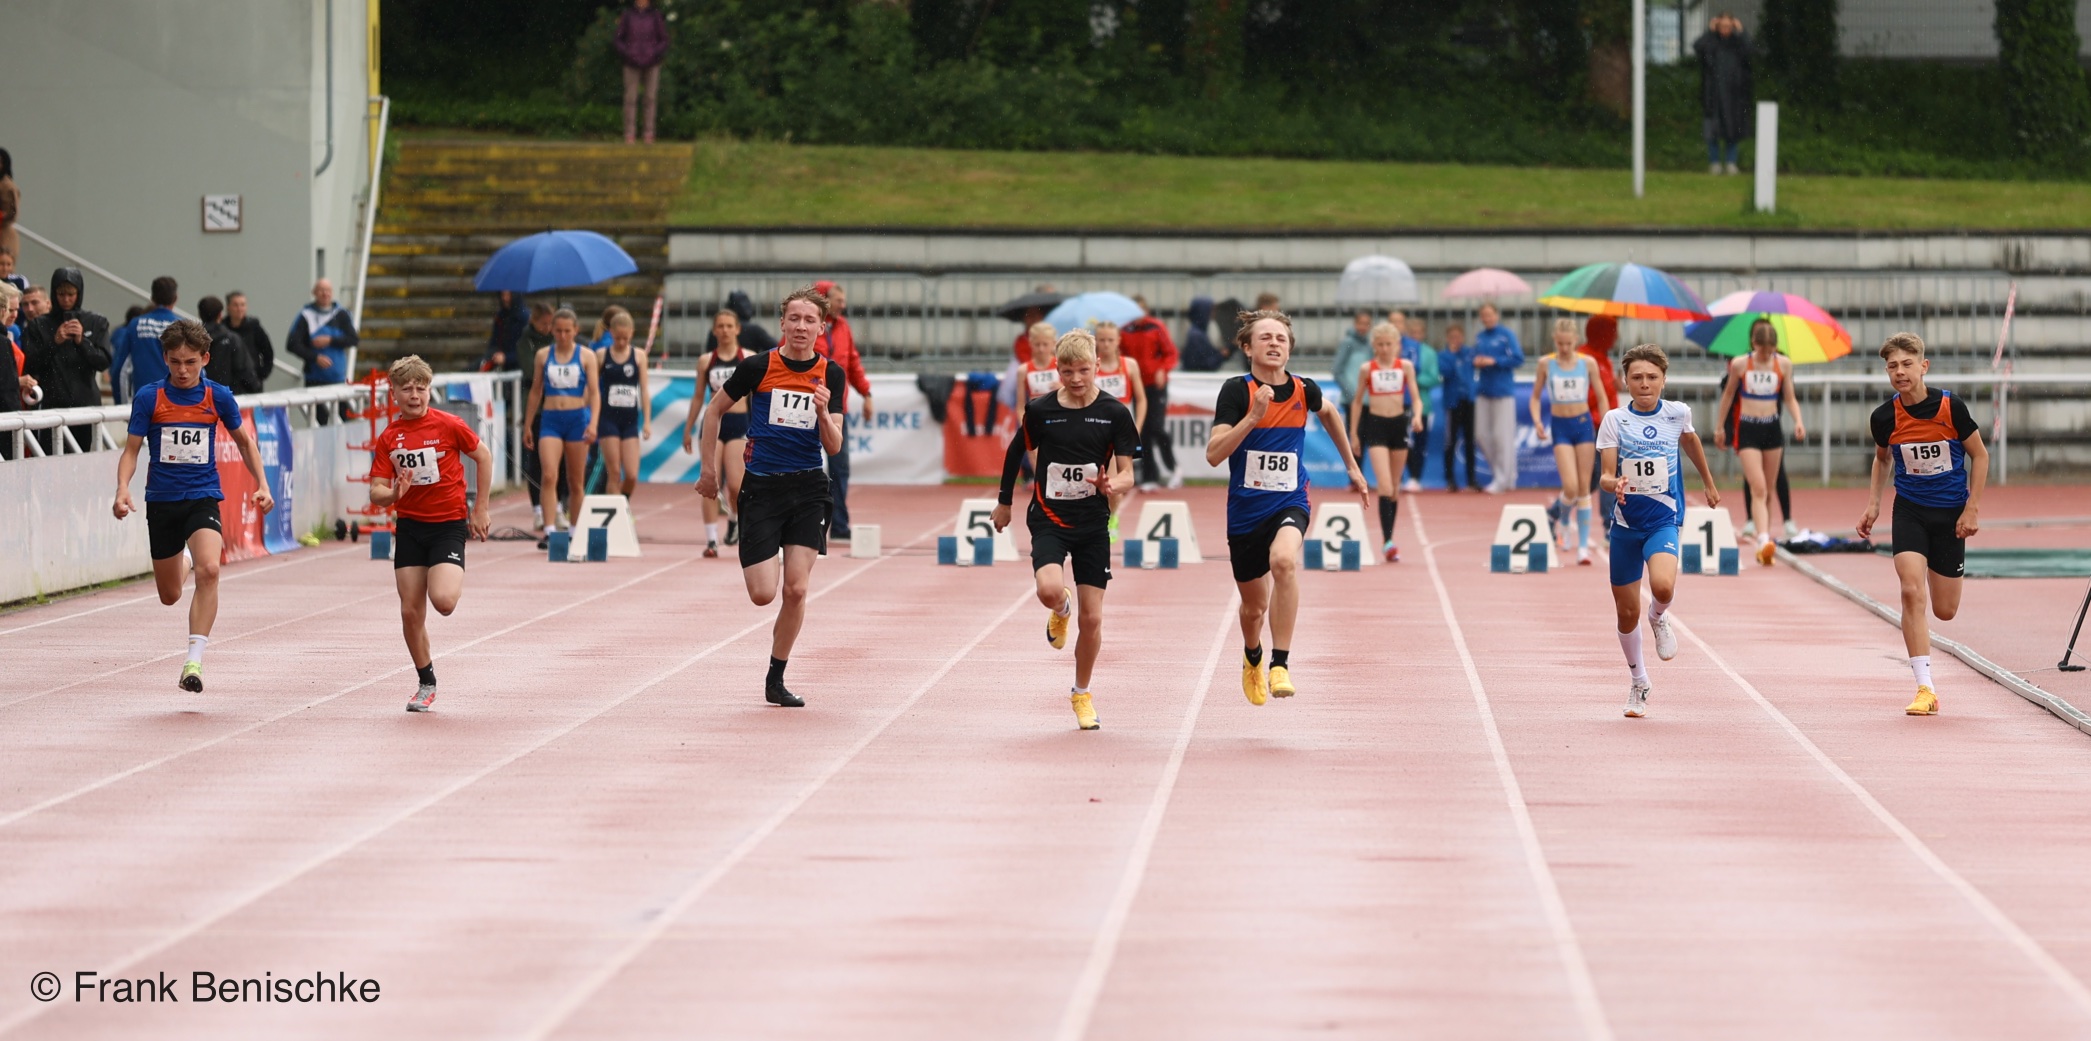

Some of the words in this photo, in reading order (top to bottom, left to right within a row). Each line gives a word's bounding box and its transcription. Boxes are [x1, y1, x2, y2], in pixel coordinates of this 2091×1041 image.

[556, 367, 570, 377] 16
[1101, 377, 1119, 387] 155
[782, 393, 811, 410] 171
[171, 429, 202, 445] 164
[396, 451, 426, 468] 281
[1910, 445, 1941, 460] 159
[1258, 455, 1289, 471] 158
[1634, 461, 1655, 476] 18
[1062, 468, 1083, 482] 46
[591, 508, 617, 528] 7
[965, 511, 993, 547] 5
[1147, 513, 1173, 541] 4
[1325, 516, 1351, 553] 3
[1511, 518, 1537, 555] 2
[1698, 521, 1714, 556] 1
